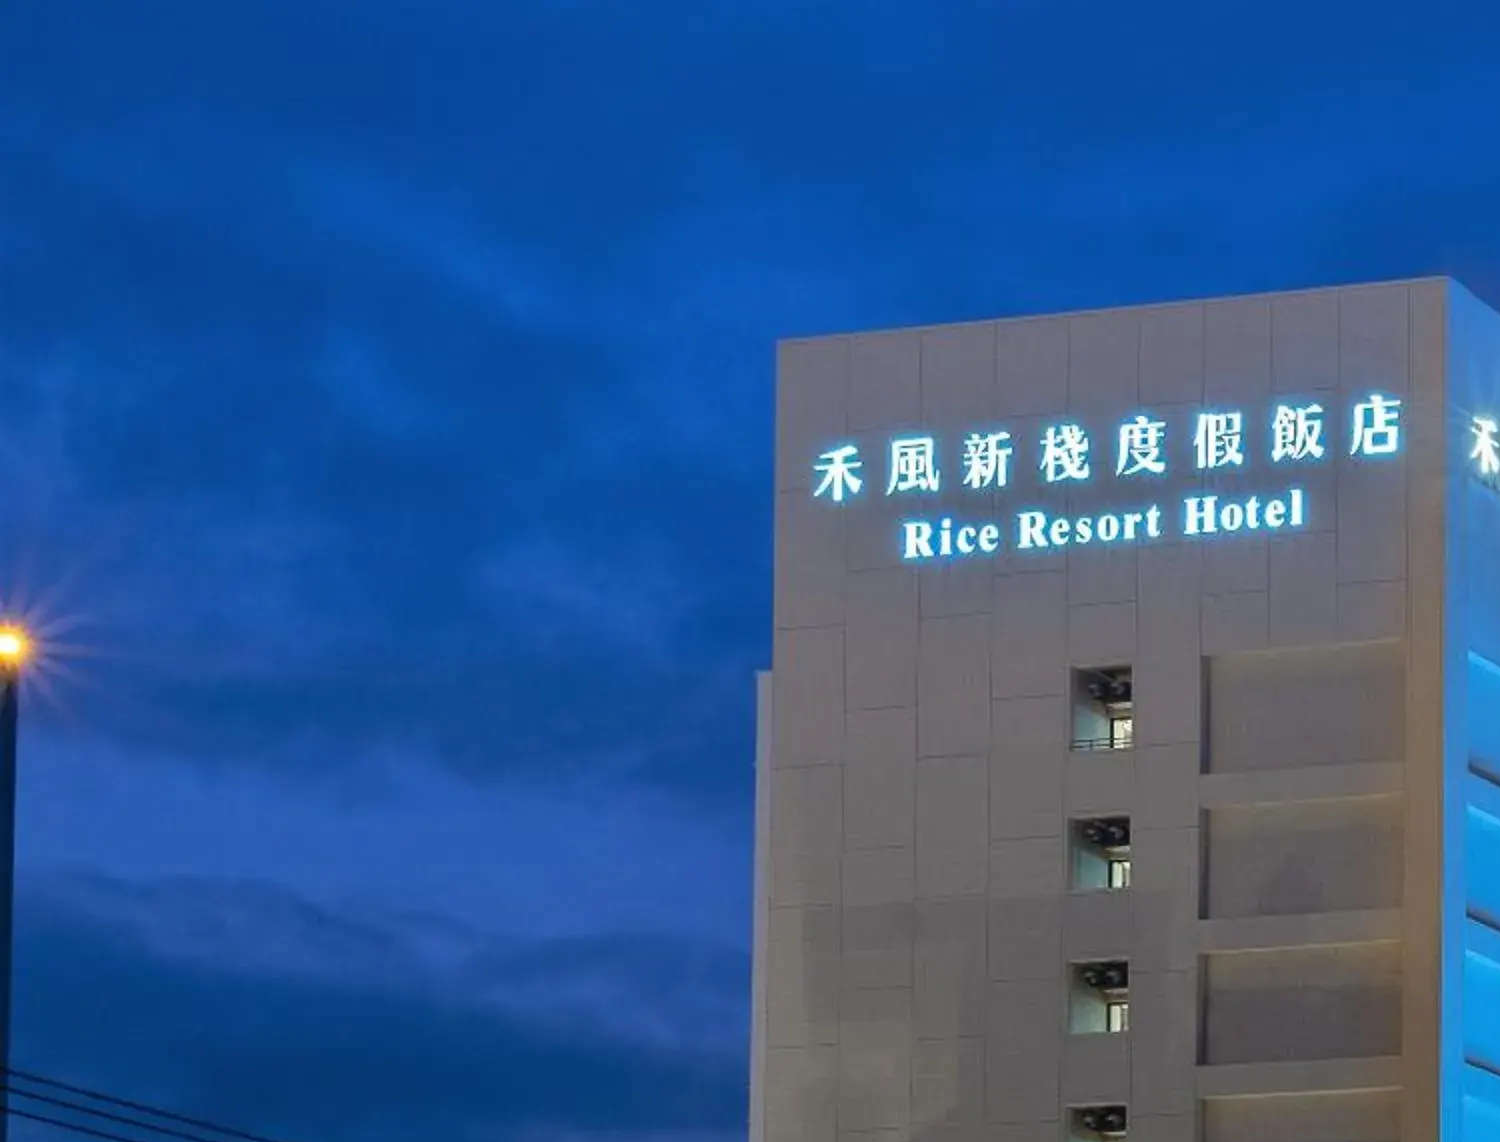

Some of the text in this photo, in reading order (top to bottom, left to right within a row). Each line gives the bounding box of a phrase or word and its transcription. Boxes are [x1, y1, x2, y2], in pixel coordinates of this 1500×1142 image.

[812, 394, 1402, 501] 禾風新棧度假飯店
[903, 489, 1304, 559] Rice Resort Hotel
